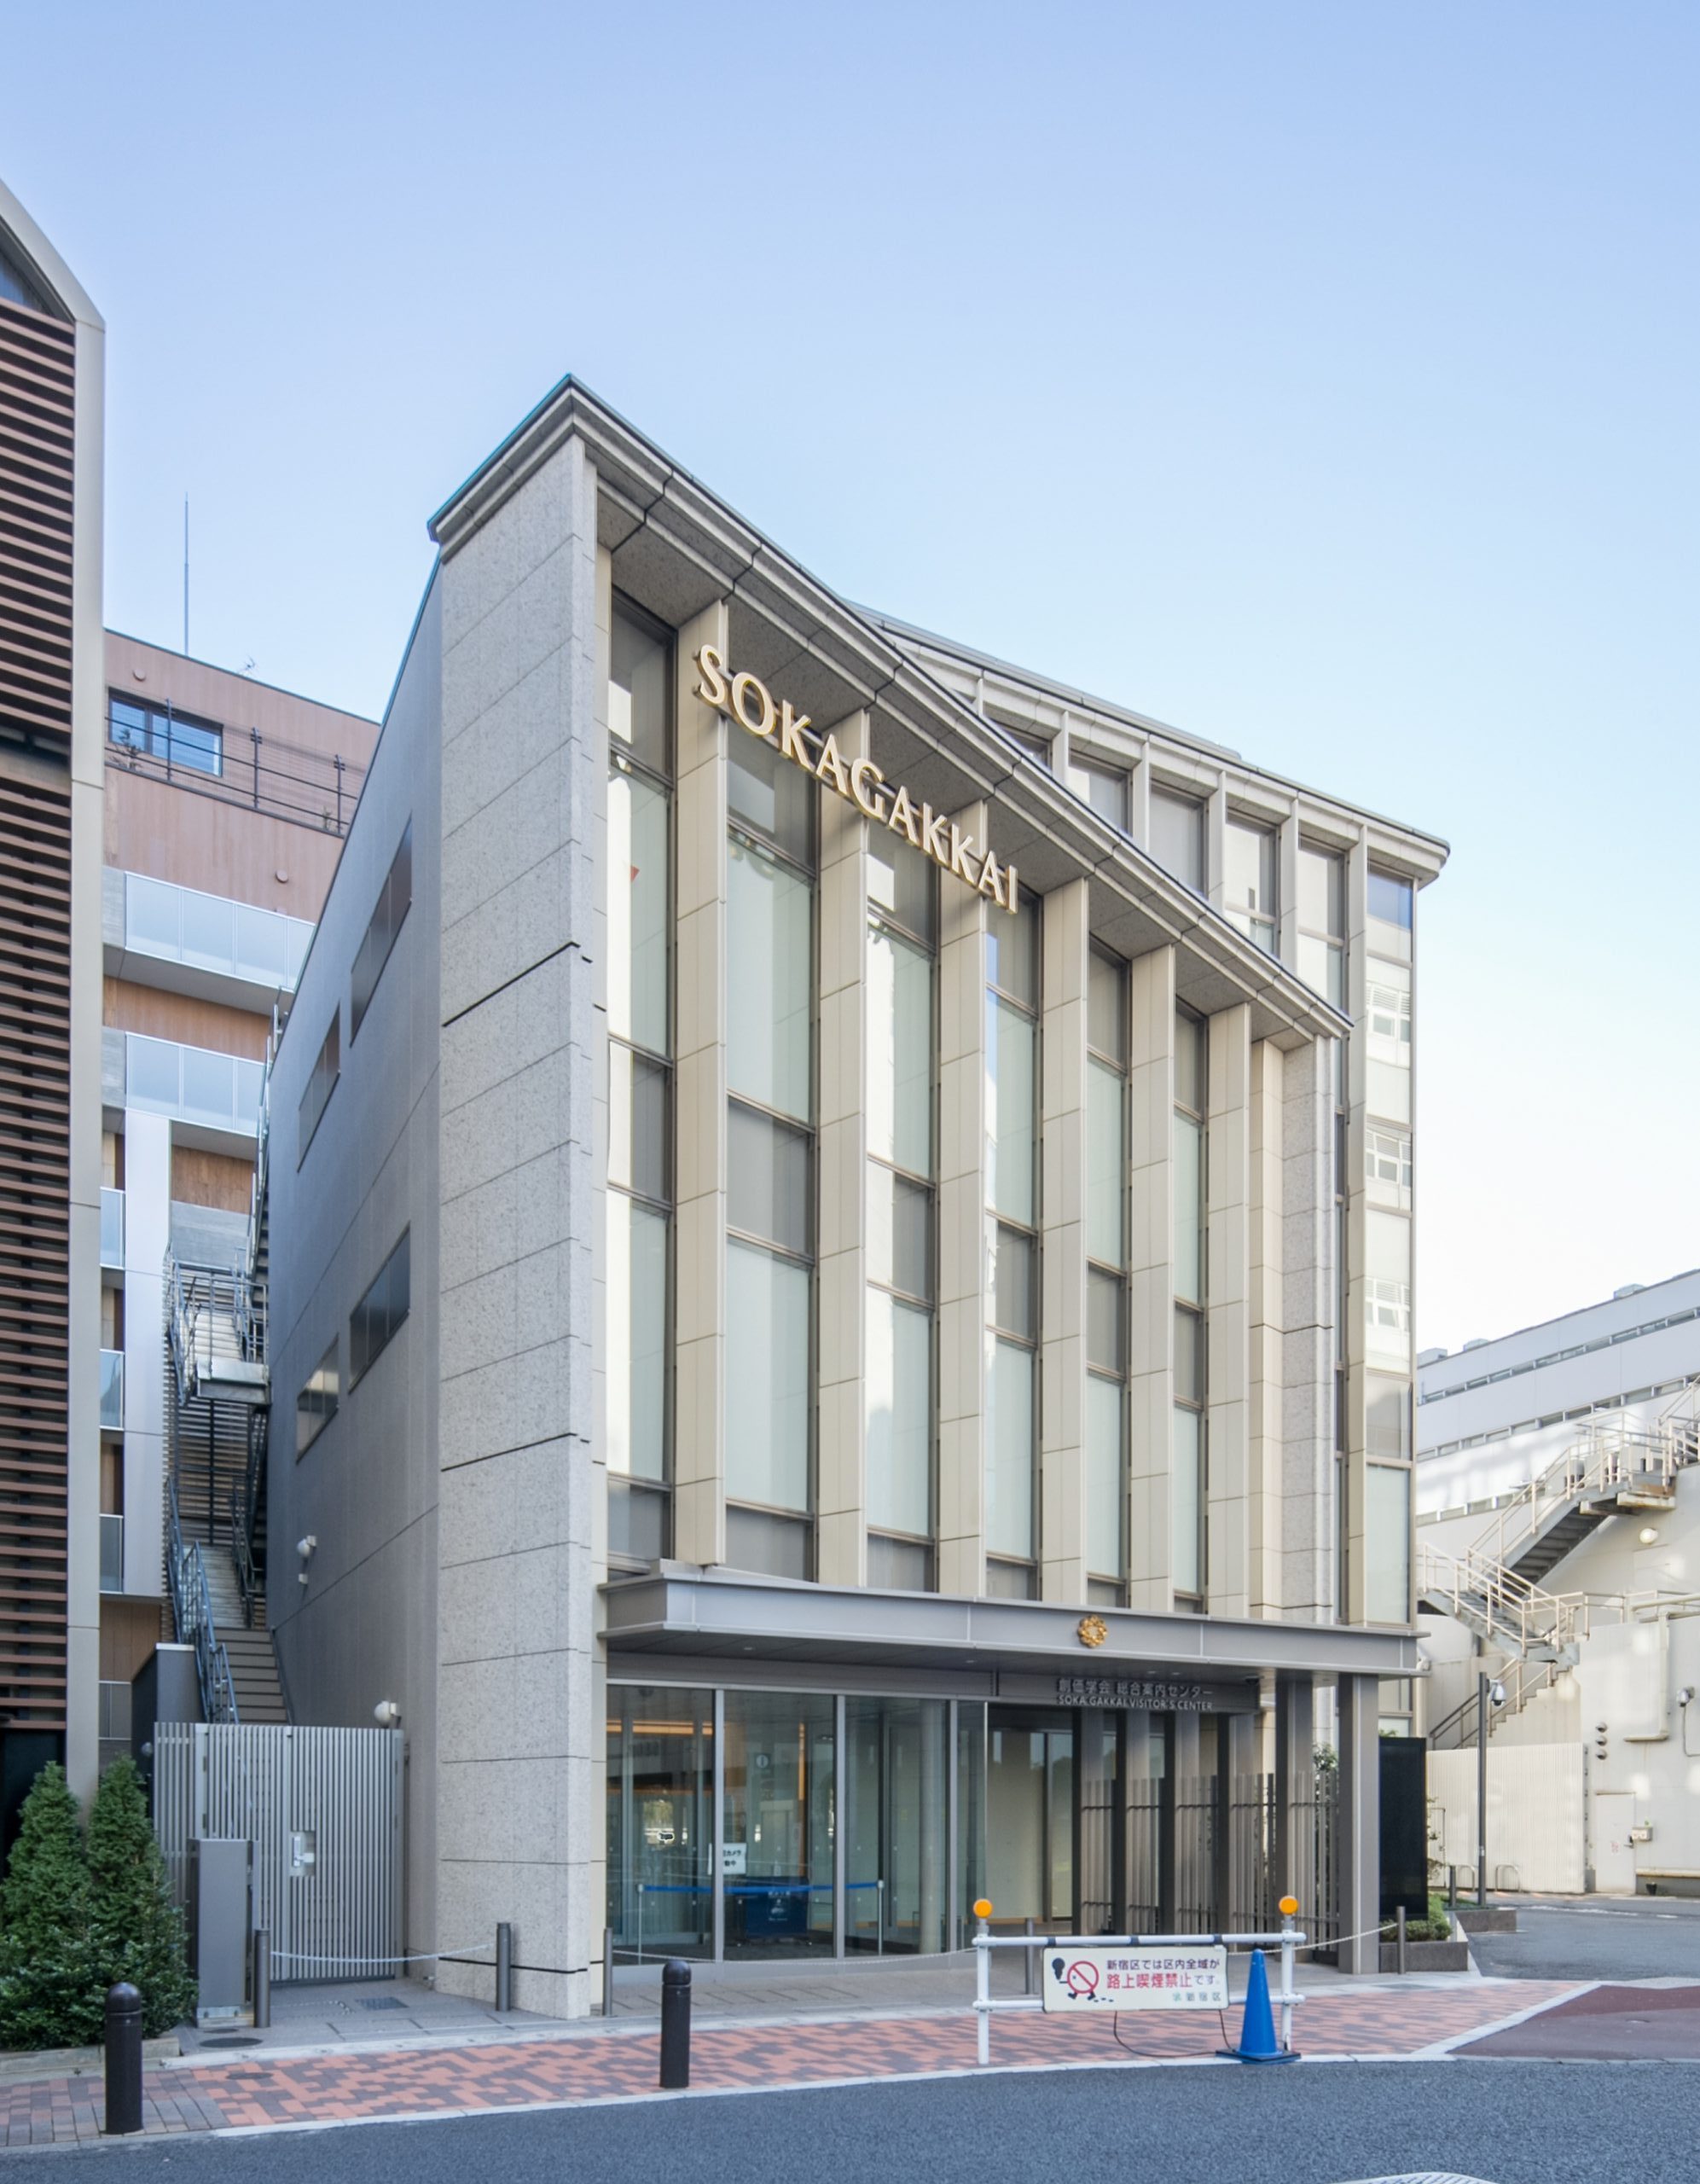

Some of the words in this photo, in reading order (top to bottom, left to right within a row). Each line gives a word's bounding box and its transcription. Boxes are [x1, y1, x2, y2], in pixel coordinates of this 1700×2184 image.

[694, 644, 1018, 914] SOKAGAKKAI
[1059, 1694, 1086, 1705] SOKA
[1089, 1696, 1126, 1707] GAKKAI
[1129, 1698, 1175, 1710] VISITOR'S
[1177, 1700, 1213, 1711] CENTER
[1106, 1959, 1220, 1970] 新宿区では区内全域が
